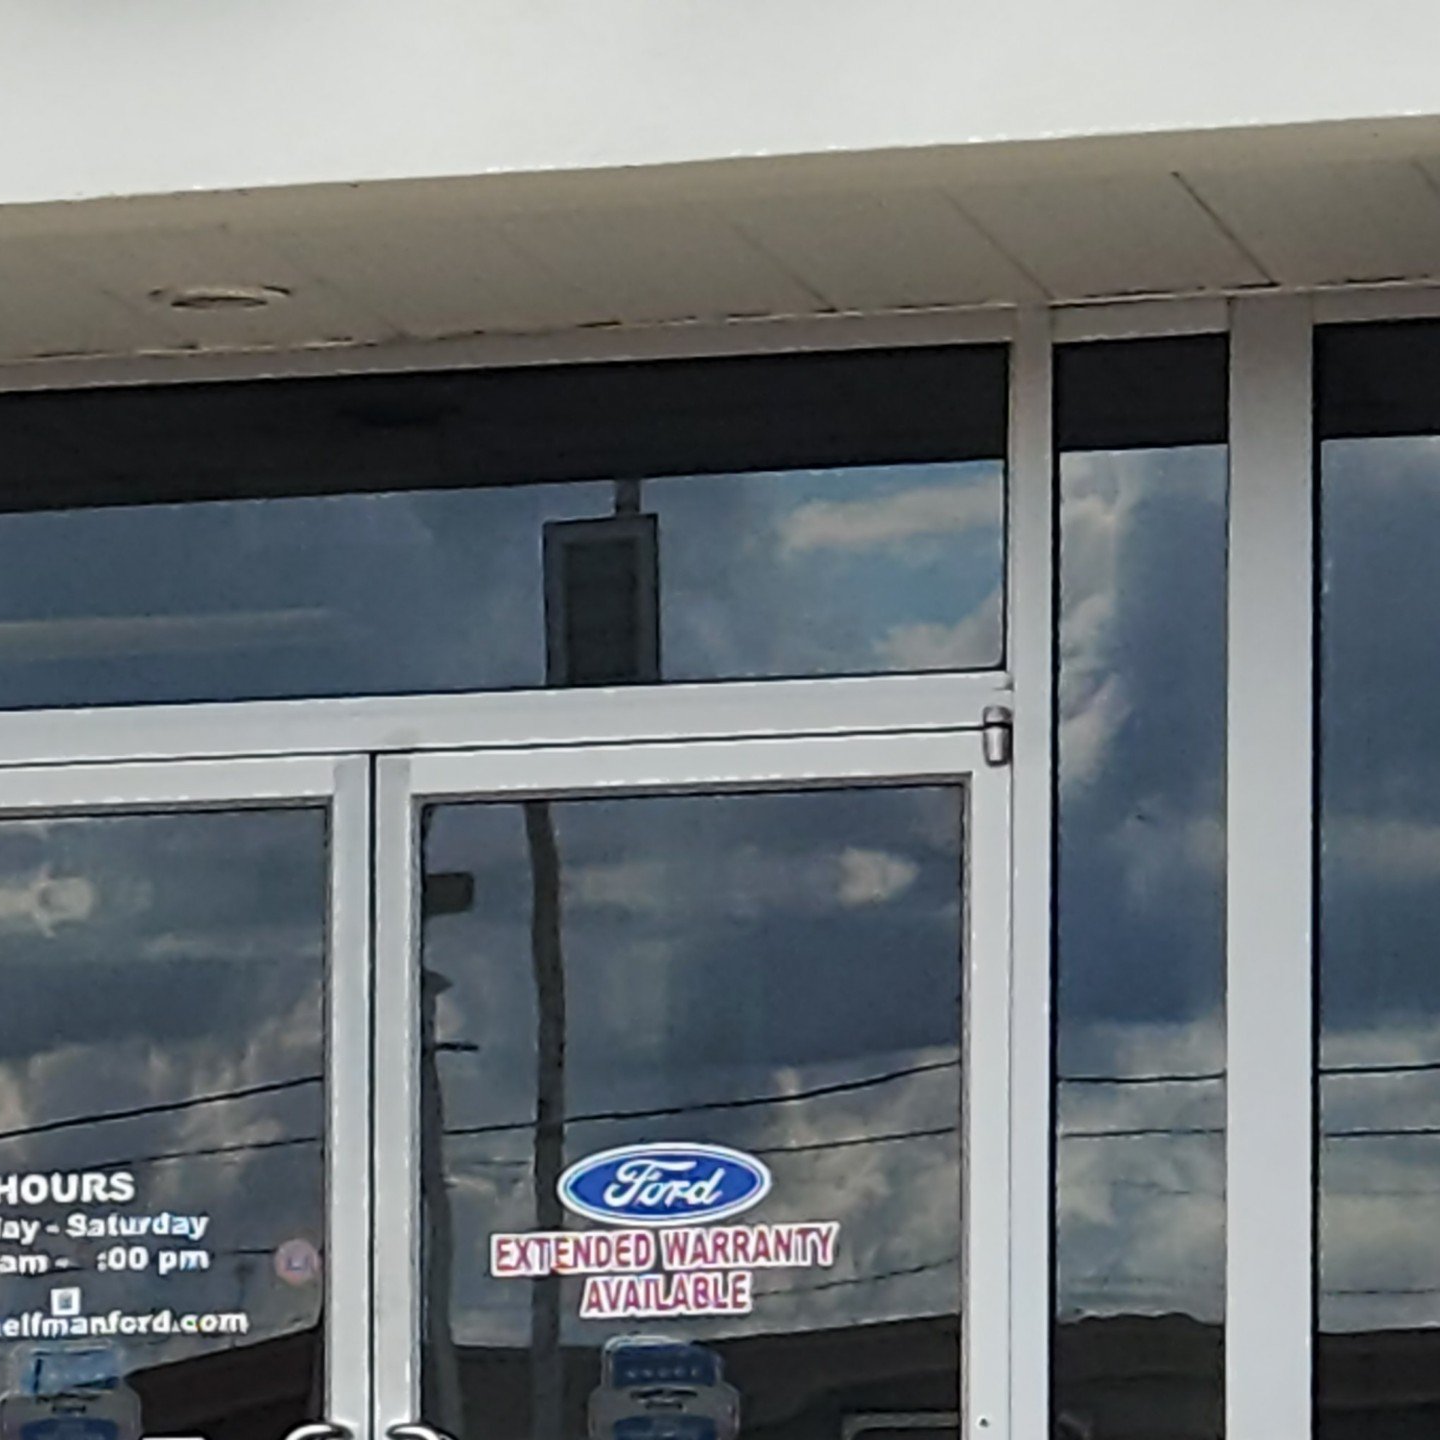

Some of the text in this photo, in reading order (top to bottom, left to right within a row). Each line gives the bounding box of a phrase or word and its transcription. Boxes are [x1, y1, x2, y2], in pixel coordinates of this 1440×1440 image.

[603, 1158, 726, 1207] Ford
[64, 1212, 210, 1241] Saturday
[158, 1247, 210, 1276] pm
[494, 1225, 836, 1272] EXTENDED WARRANTY
[583, 1271, 749, 1314] AVAILABLE
